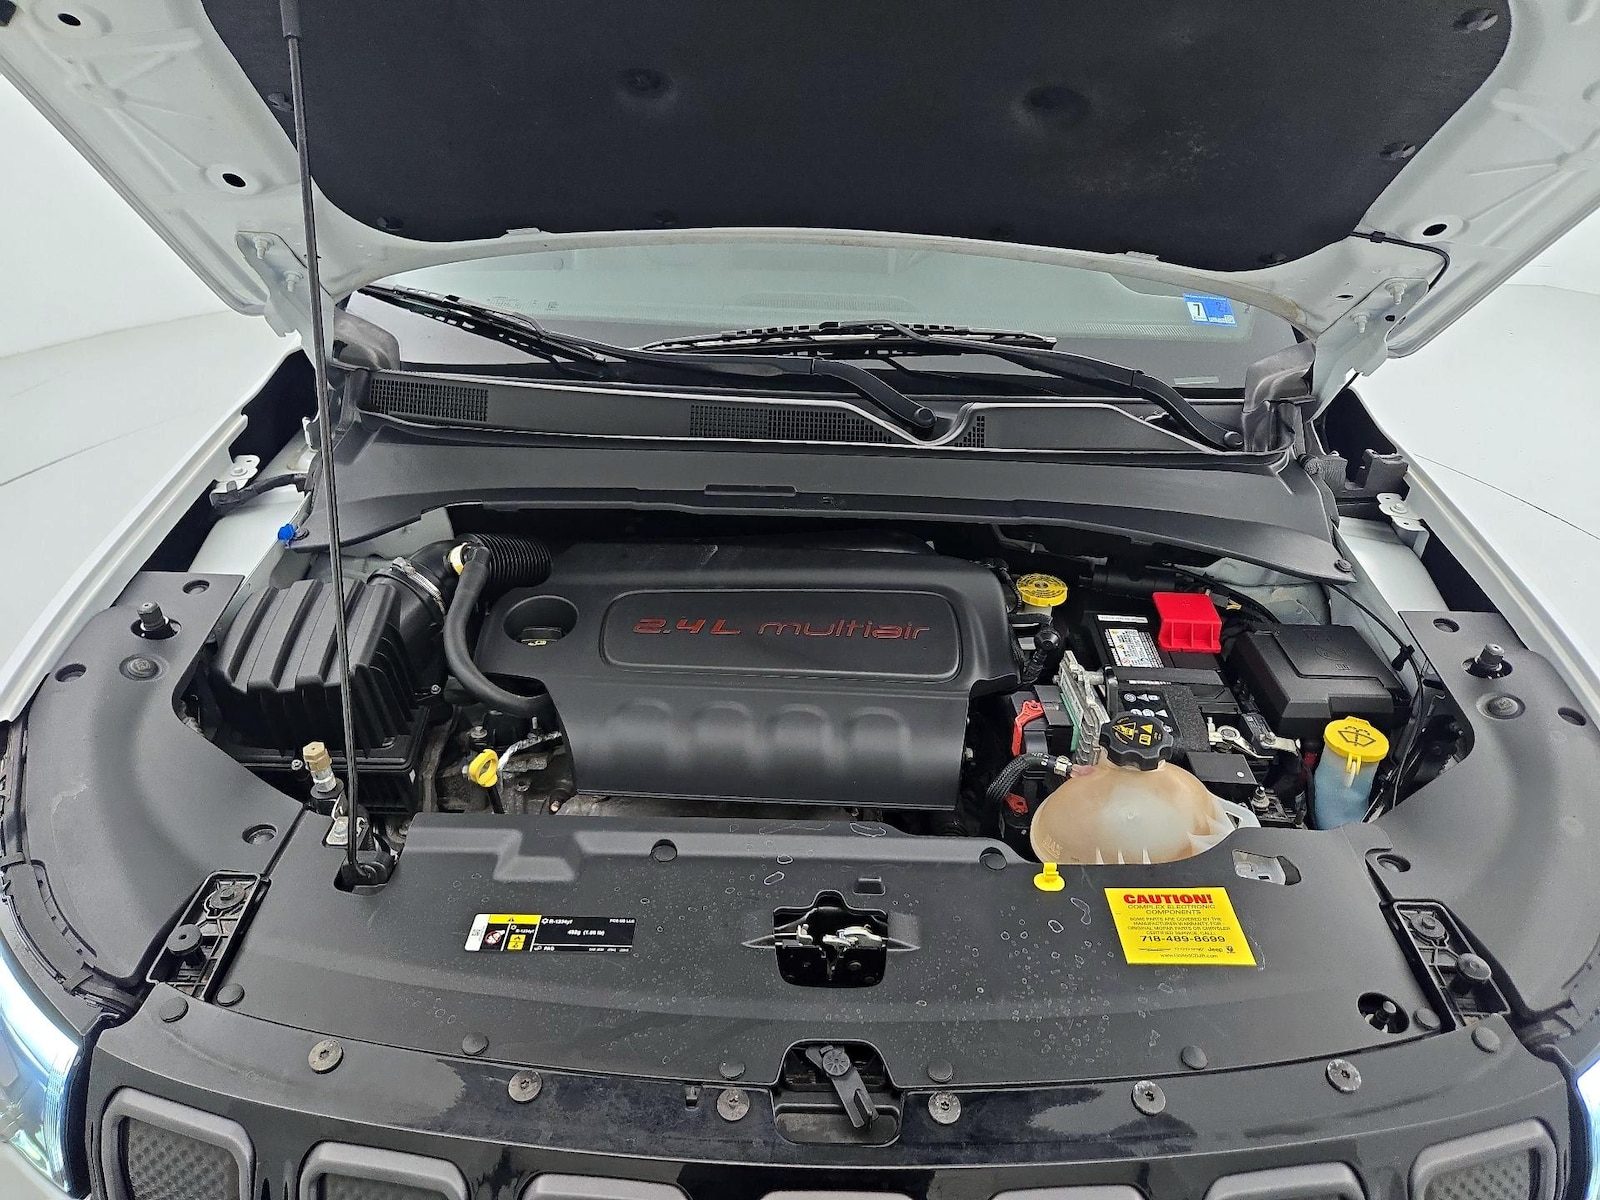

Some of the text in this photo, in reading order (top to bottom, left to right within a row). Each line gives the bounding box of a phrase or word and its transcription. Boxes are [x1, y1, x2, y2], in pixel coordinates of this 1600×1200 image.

[1192, 304, 1200, 316] 7
[757, 618, 931, 640] multiair
[1124, 894, 1213, 904] CAUTION!
